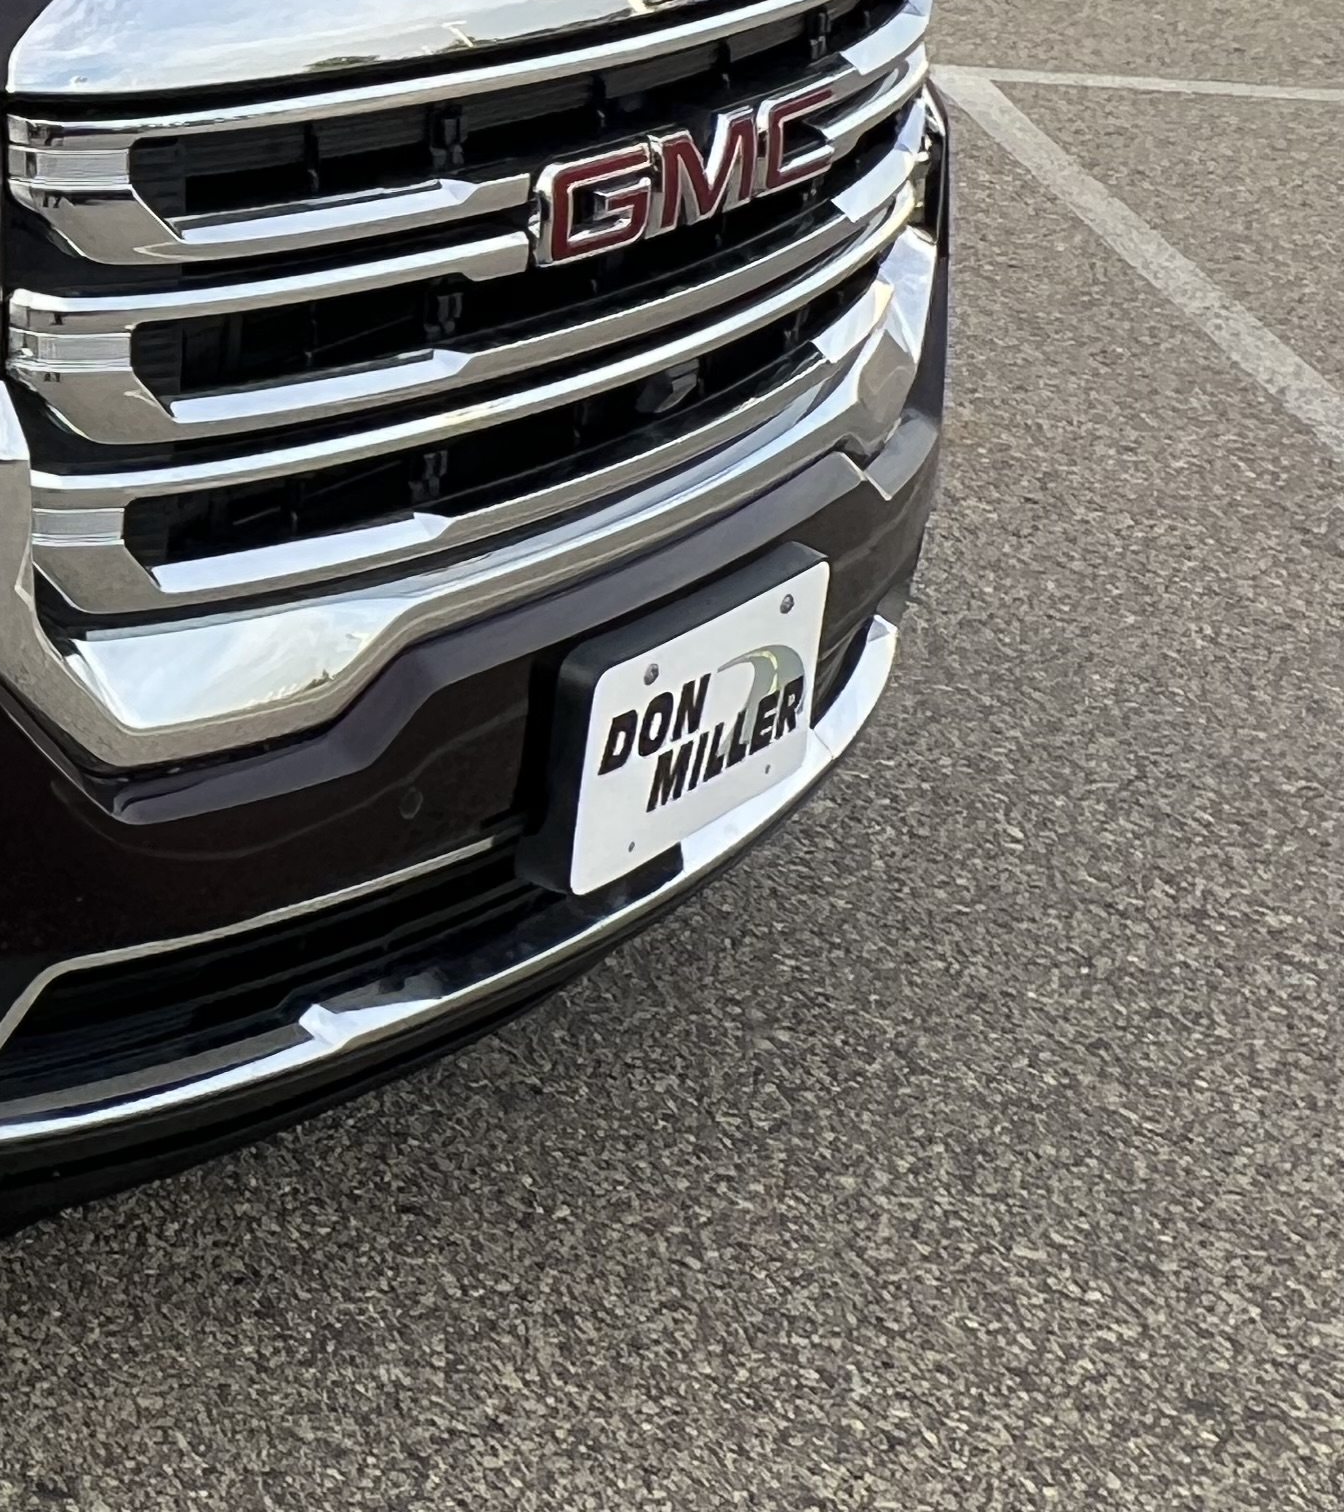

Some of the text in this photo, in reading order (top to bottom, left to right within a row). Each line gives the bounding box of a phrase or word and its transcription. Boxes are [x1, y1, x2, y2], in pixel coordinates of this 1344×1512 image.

[534, 88, 835, 268] GMC
[597, 673, 712, 776] DON
[646, 675, 804, 813] MILLER
